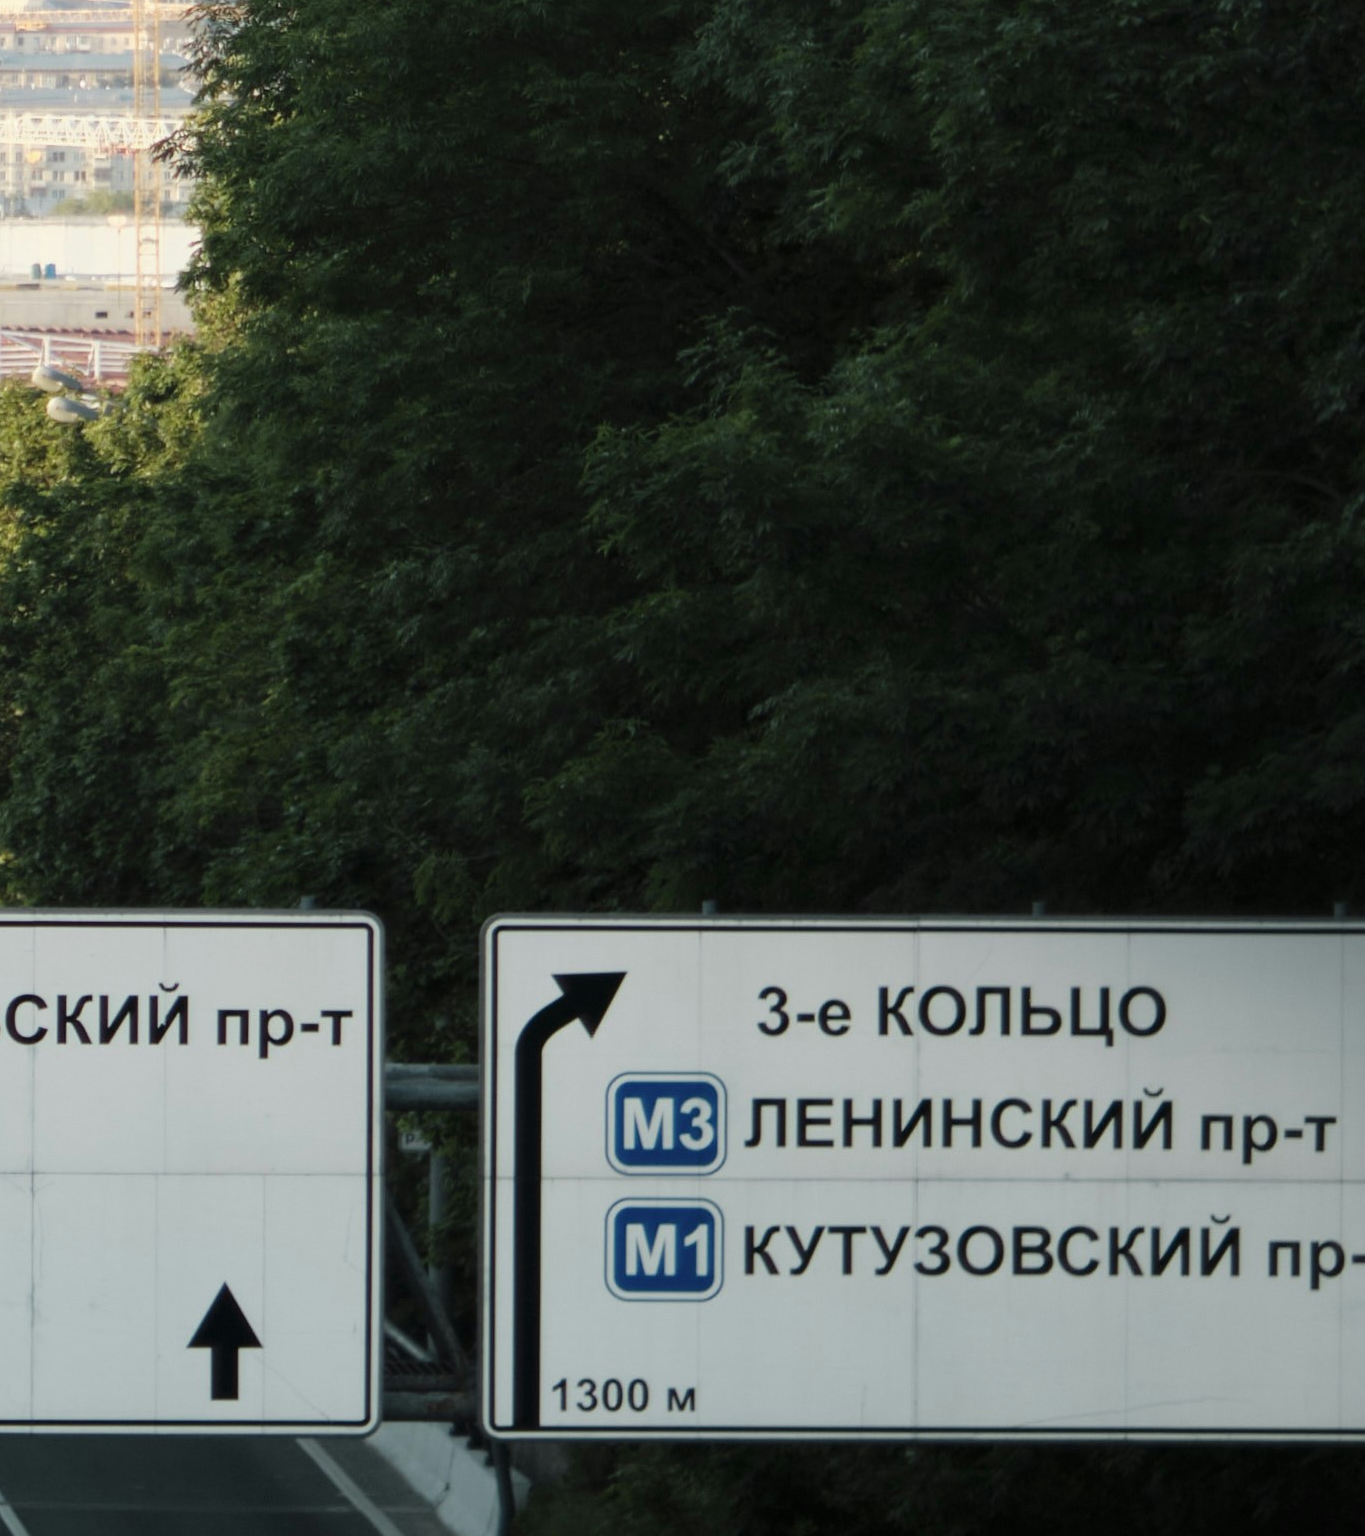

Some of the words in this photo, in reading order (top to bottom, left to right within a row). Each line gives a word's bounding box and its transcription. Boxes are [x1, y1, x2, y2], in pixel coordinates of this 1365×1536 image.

[217, 1009, 353, 1059] пр-т
[758, 986, 852, 1037] 3-е
[878, 985, 1167, 1047] КОЛЬЦО
[623, 1096, 715, 1151] М3
[744, 1088, 1173, 1150] ЛЕНИНСКИЙ
[1201, 1114, 1337, 1165] пр-т
[625, 1223, 709, 1277] М1
[744, 1215, 1240, 1277] КУТУЗОВСКИЙ
[552, 1378, 649, 1412] 1300
[667, 1387, 696, 1412] м
